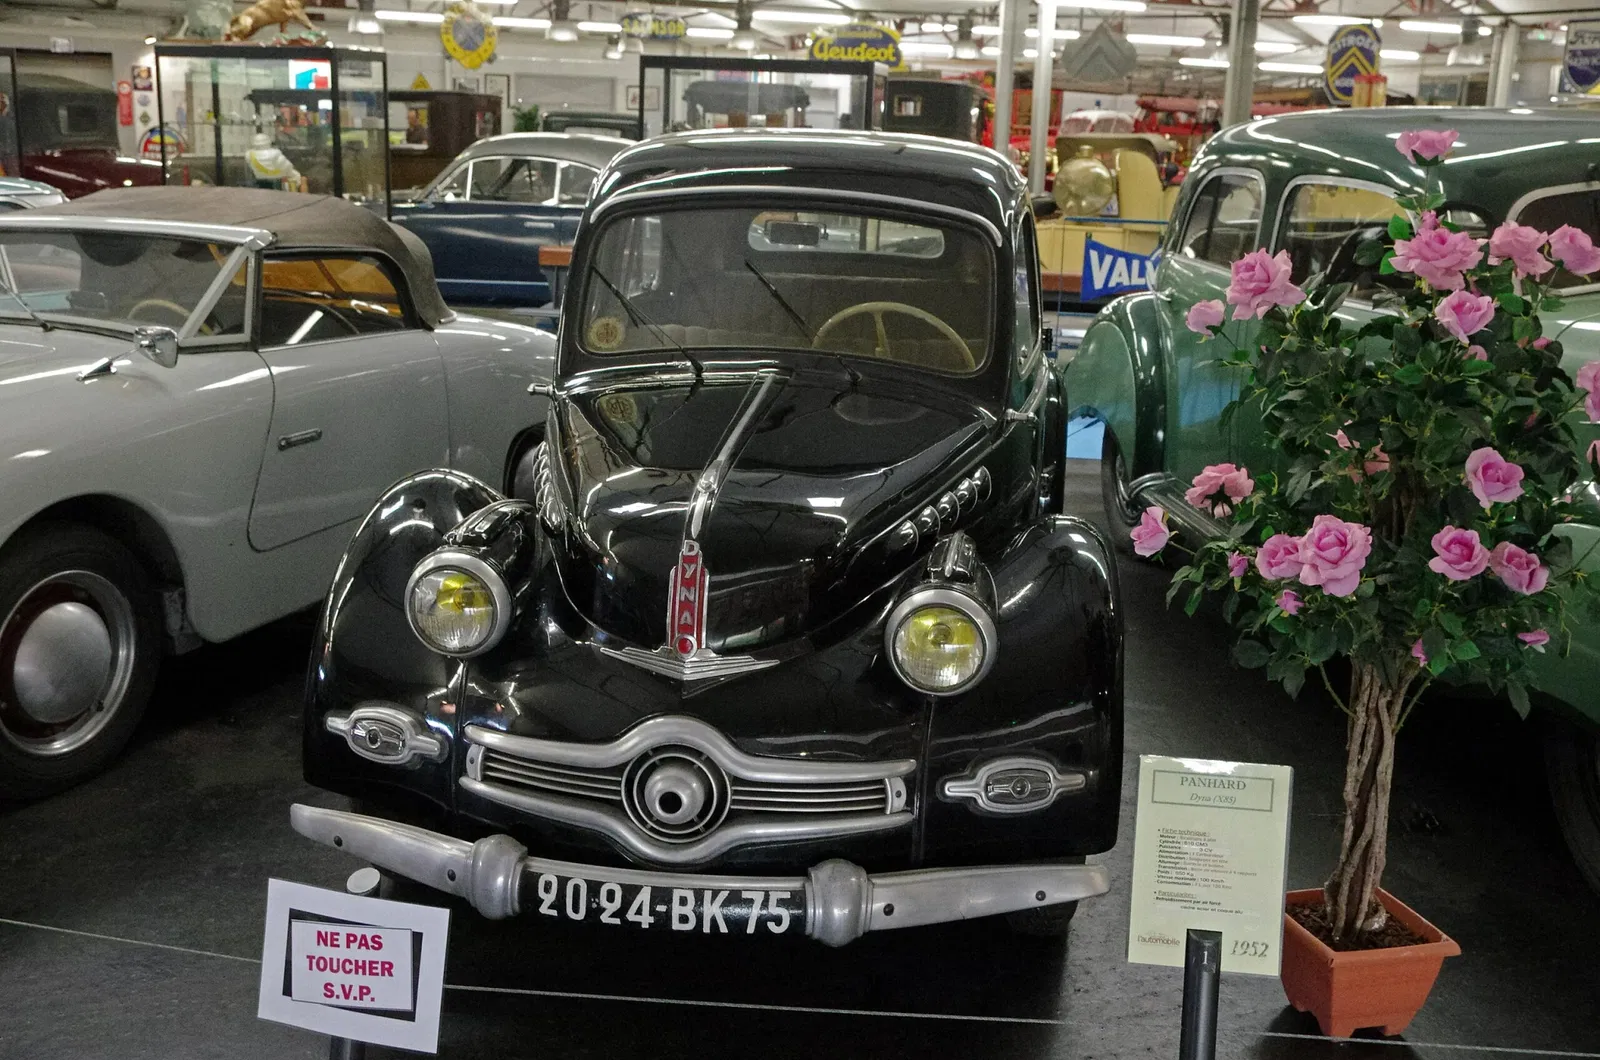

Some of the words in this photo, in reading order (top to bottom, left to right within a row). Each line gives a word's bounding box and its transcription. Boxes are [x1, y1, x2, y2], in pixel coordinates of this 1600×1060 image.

[680, 540, 700, 625] DYNA
[1180, 776, 1247, 790] PANHARD
[1190, 793, 1212, 804] Dyna
[1213, 795, 1237, 805] (X85)
[741, 891, 791, 934] 75
[316, 930, 341, 948] NE
[345, 933, 383, 951] PAS
[1230, 939, 1269, 958] 1952
[306, 955, 394, 978] TOUCHER
[323, 982, 375, 1002] S.V.P.
